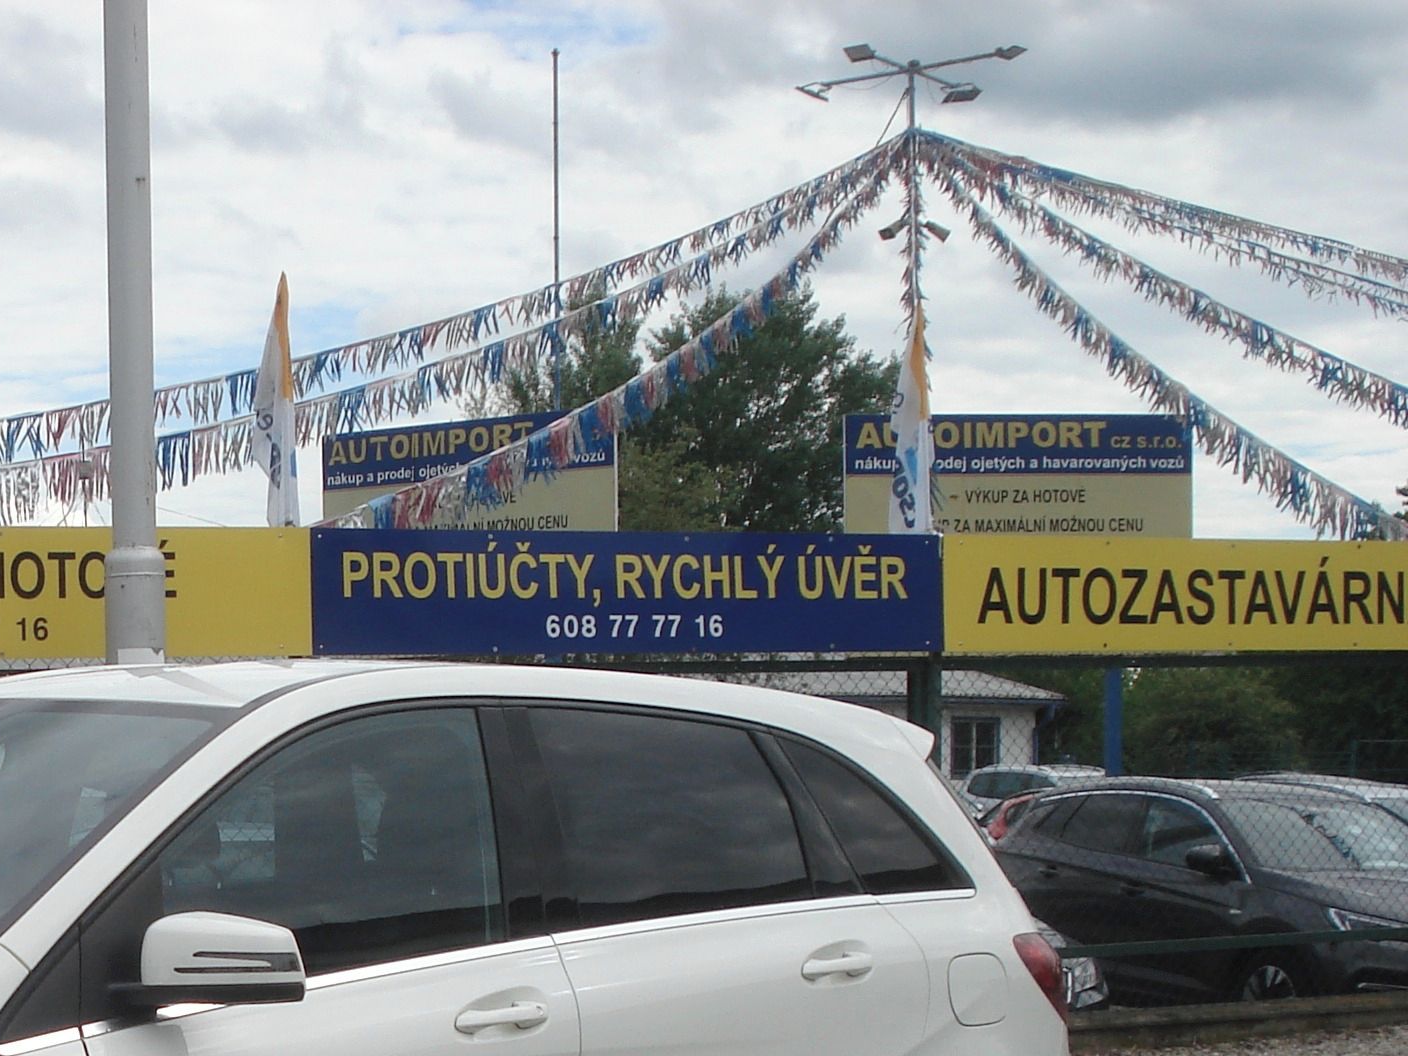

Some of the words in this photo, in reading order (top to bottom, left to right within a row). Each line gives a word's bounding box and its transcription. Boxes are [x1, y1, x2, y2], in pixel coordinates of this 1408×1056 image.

[329, 421, 533, 465] AUTOIMPORT
[856, 421, 1106, 448] AUOIMPORT
[1110, 437, 1131, 448] cz
[1136, 436, 1183, 448] s.r.o.
[935, 456, 967, 472] odej
[971, 456, 1025, 472] ojetých
[1029, 459, 1039, 469] a
[1043, 455, 1146, 471] havarovaných
[1149, 455, 1185, 469] vozů
[327, 472, 363, 486] nákup
[367, 474, 374, 482] a
[377, 466, 415, 482] prodej
[965, 487, 1008, 503] VÝKUP
[1012, 489, 1030, 503] ZA
[1033, 487, 1087, 503] HOTOVÉ
[537, 515, 568, 530] CENU
[954, 519, 971, 532] ZA
[975, 515, 1046, 532] MAXIMÁLNÍ
[1049, 515, 1104, 532] MOŽNOU
[1109, 518, 1144, 532] CENU
[342, 541, 601, 607] PROTIÚČTY,
[615, 544, 785, 600] RYCHLÝ
[797, 544, 909, 600] ÚVĚR
[977, 556, 1405, 625] AUTOZASTAVÁRN
[16, 617, 48, 641] 16
[546, 614, 597, 638] 608
[608, 614, 639, 638] 77
[651, 614, 682, 638] 77
[695, 614, 724, 638] 16
